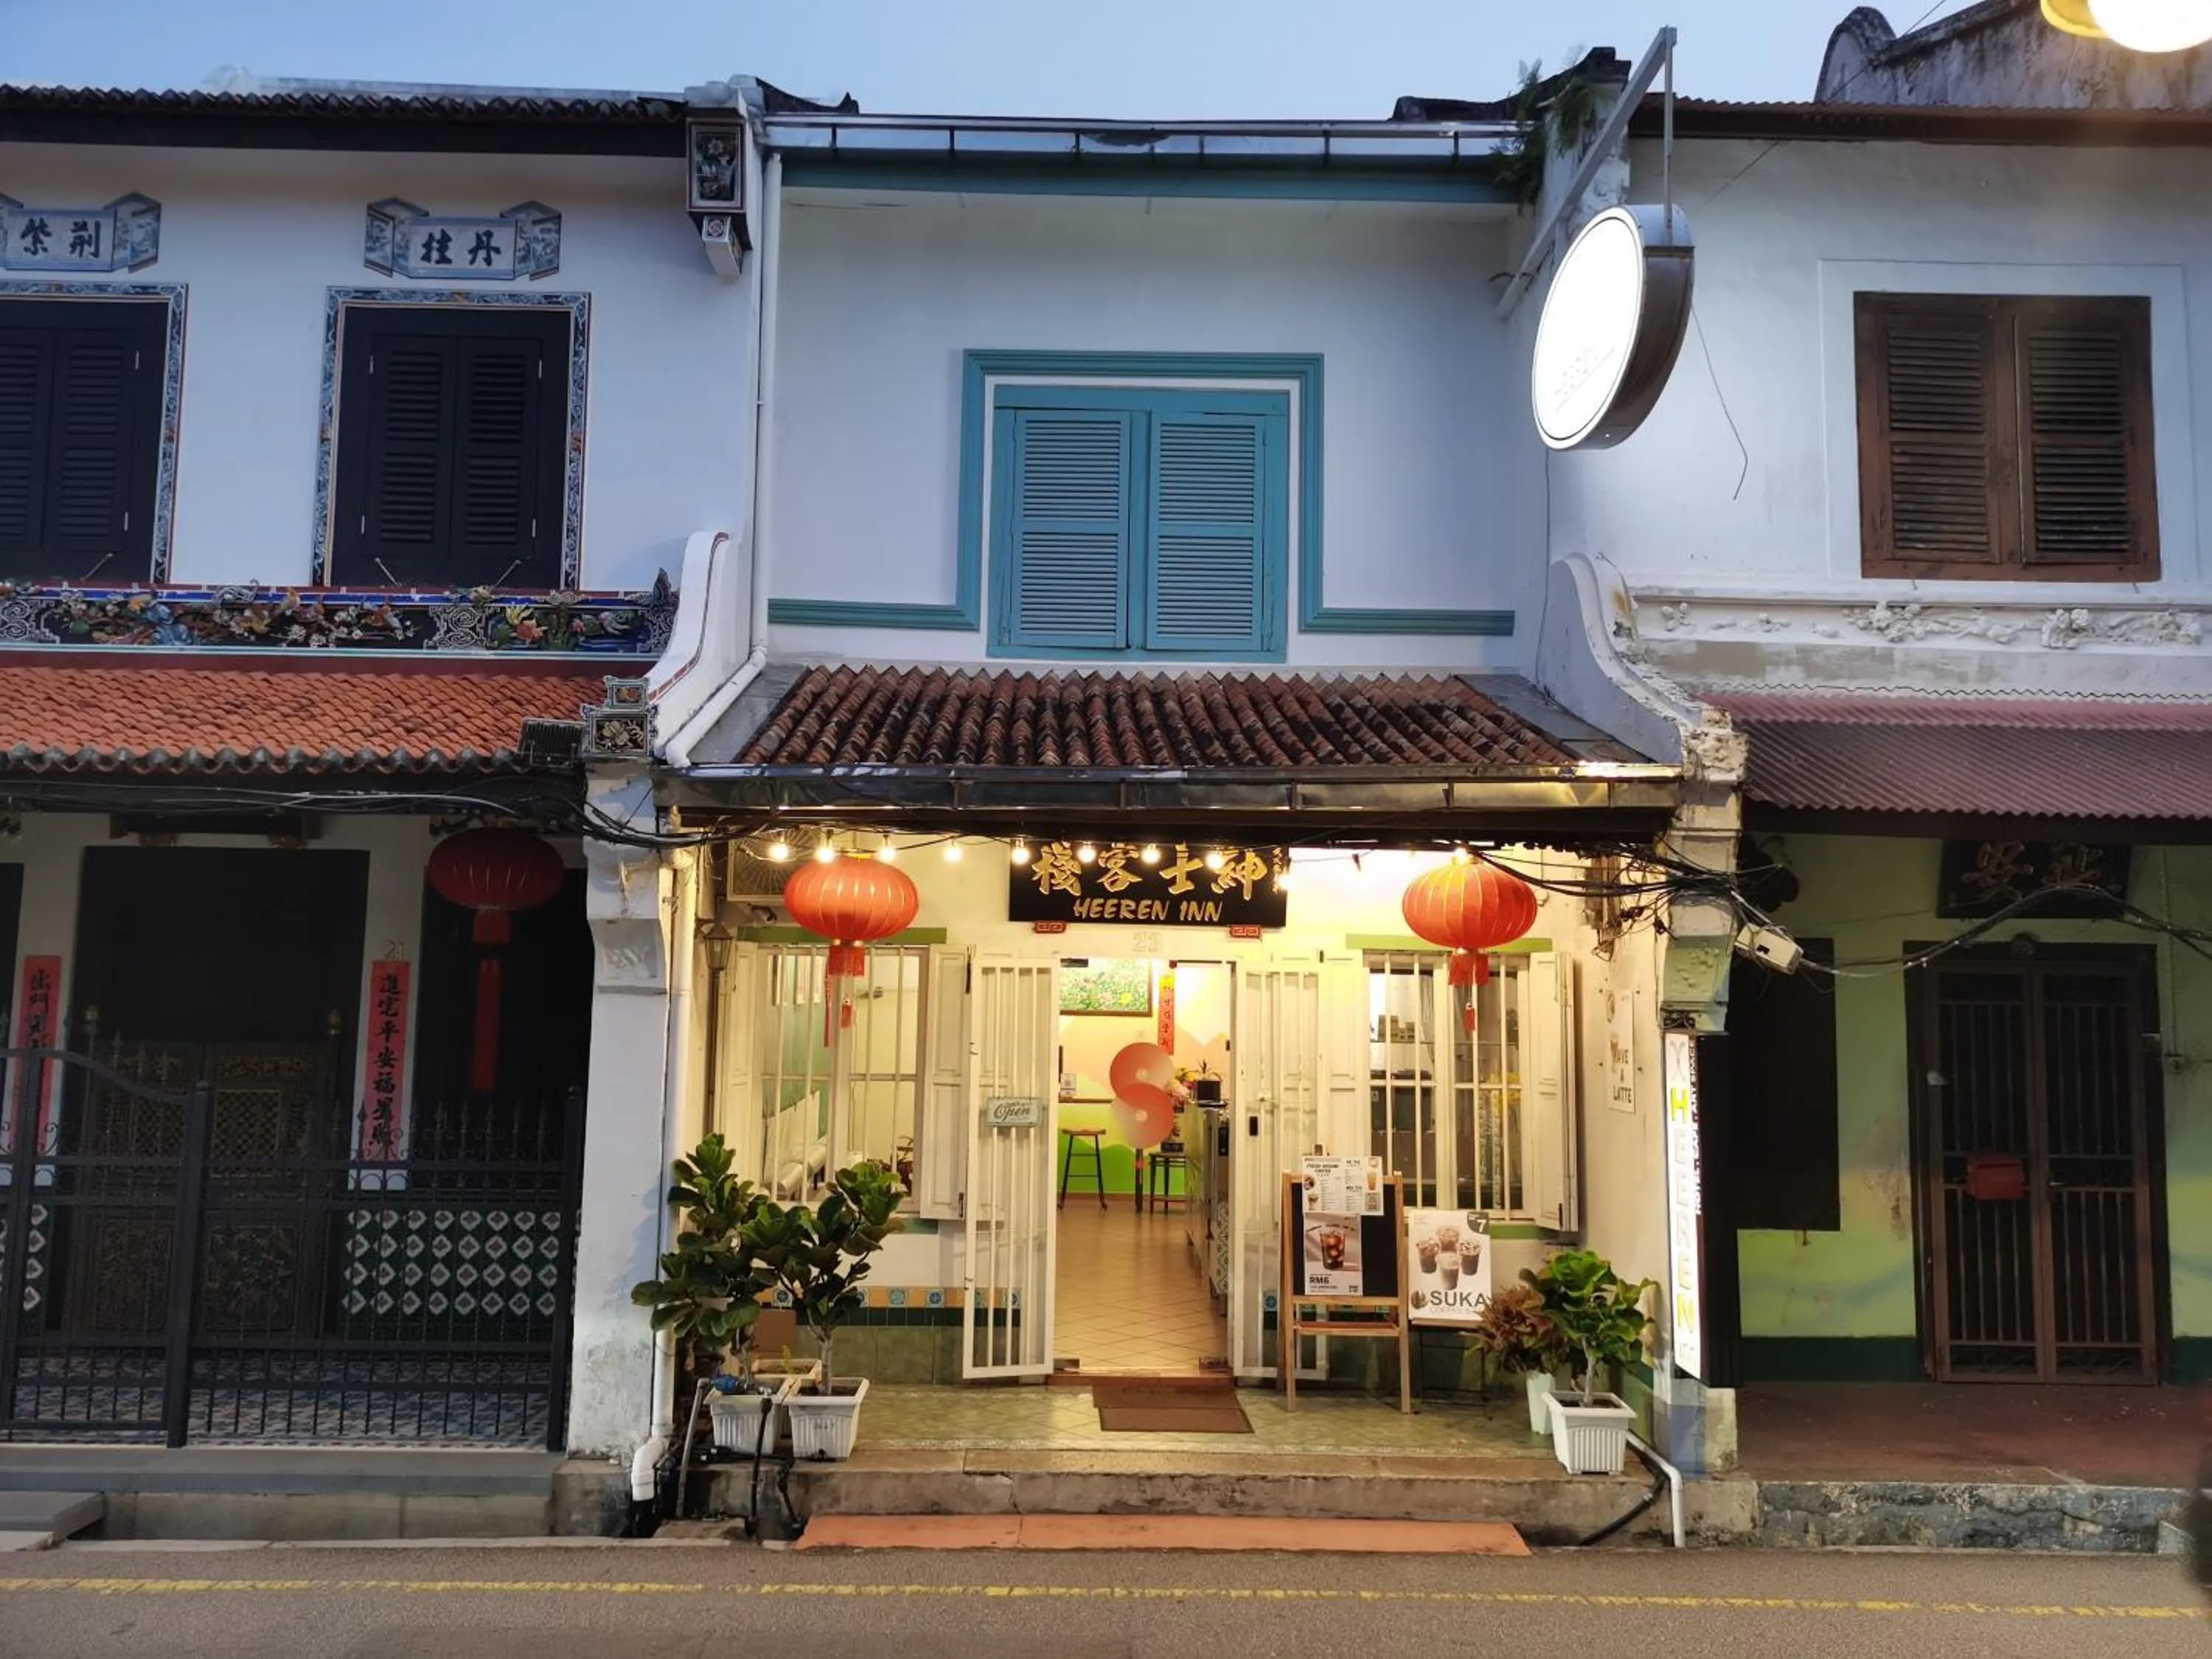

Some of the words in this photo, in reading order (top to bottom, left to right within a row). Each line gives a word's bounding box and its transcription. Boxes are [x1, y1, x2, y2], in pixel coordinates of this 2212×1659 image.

[1074, 897, 1170, 921] HEEREN
[1180, 900, 1223, 922] INN
[1613, 1085, 1632, 1104] LATTE
[993, 1102, 1032, 1121] Open
[1477, 1219, 1487, 1233] 7
[1430, 1290, 1486, 1307] SUKA
